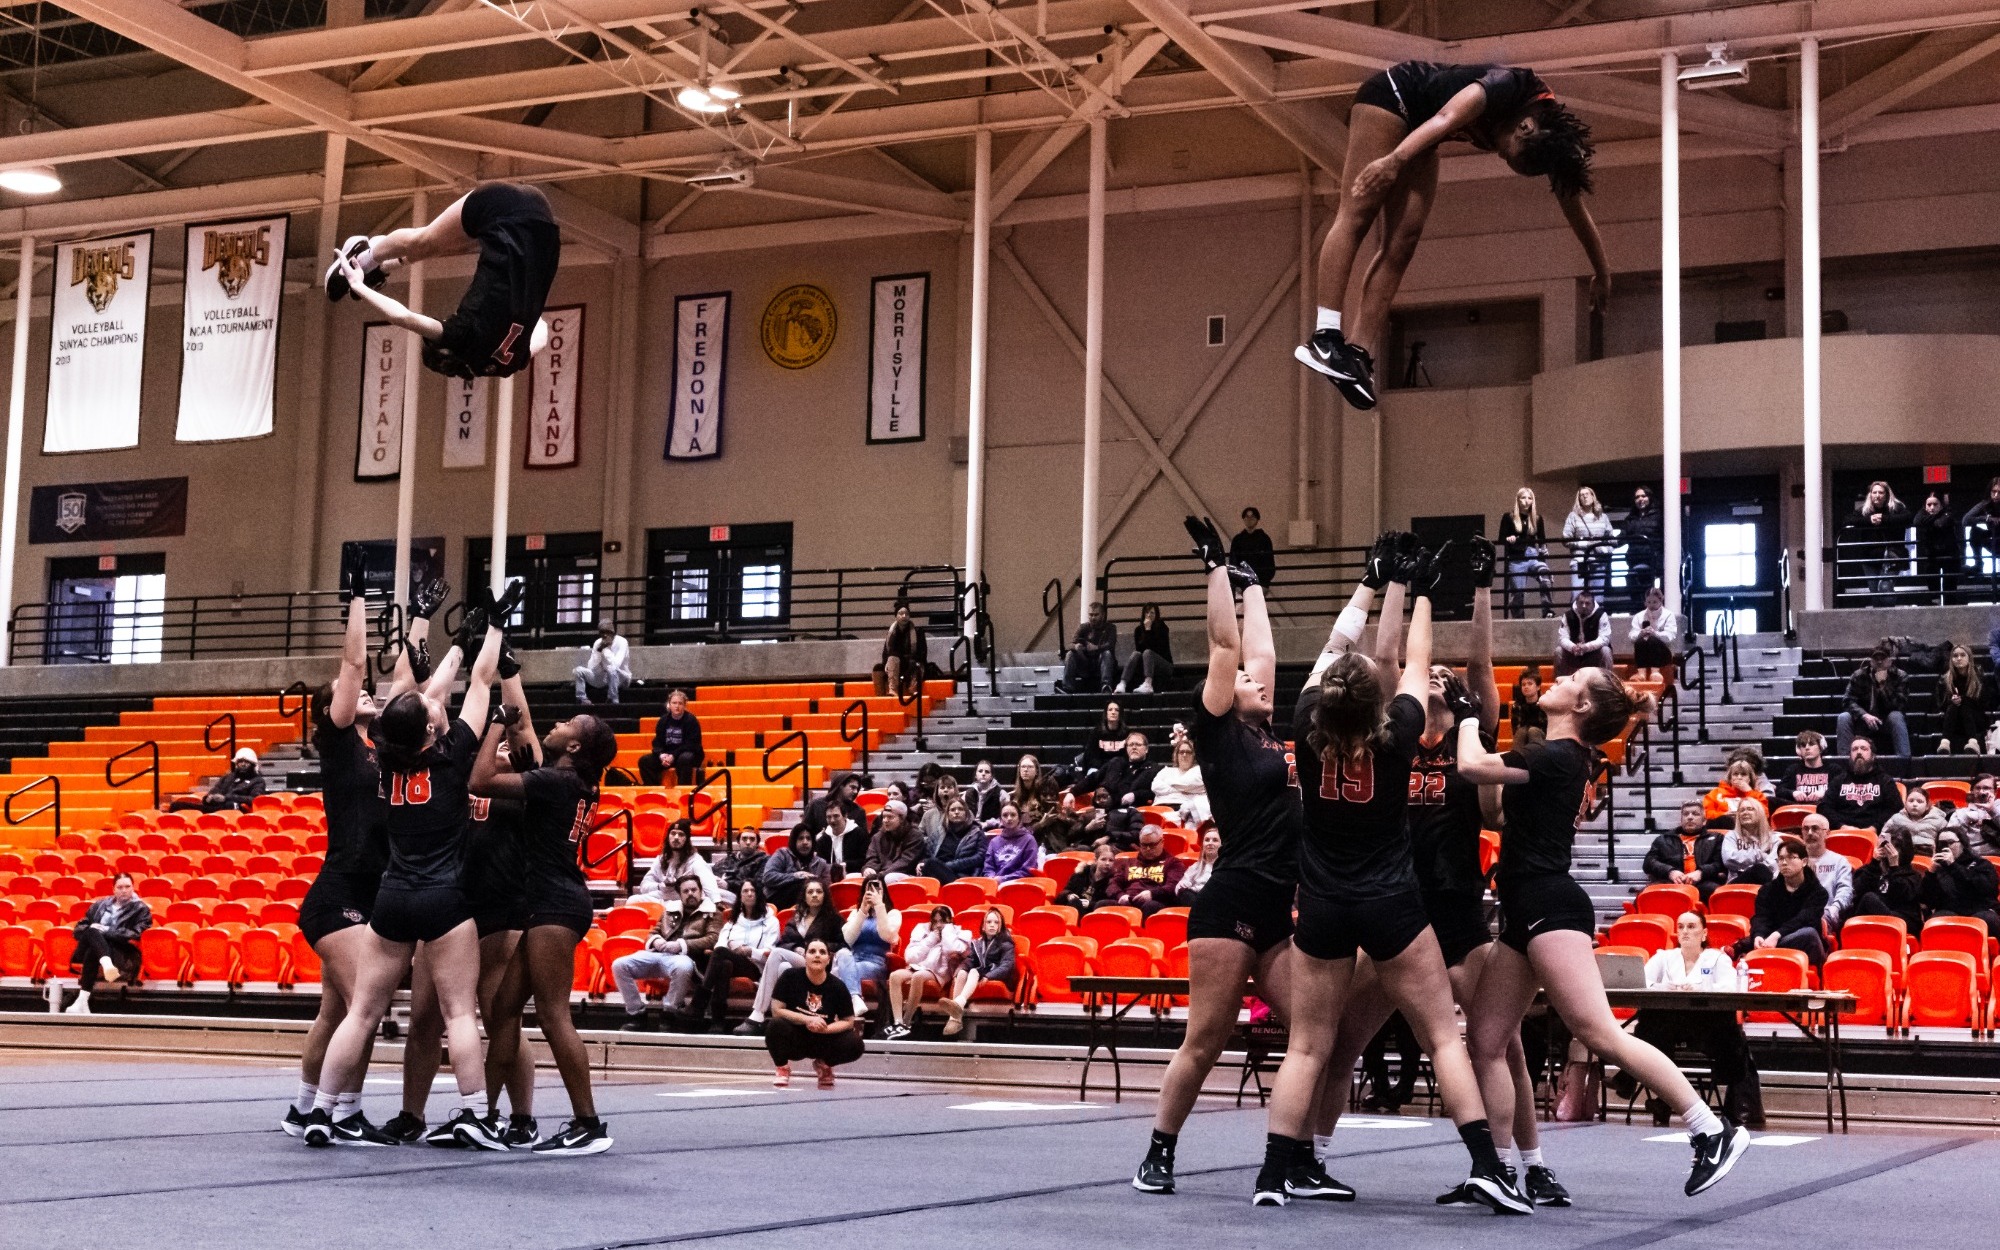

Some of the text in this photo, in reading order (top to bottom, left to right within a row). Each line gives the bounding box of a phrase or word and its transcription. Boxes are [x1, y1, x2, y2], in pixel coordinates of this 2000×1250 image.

[72, 320, 124, 334] VOLLEYBALL
[189, 319, 274, 336] NCAA TOURNAMENT
[204, 306, 260, 320] VOLLEYBALL
[59, 333, 138, 351] SUNYAC CHAMPIONS
[889, 285, 906, 432] MORRISVILLE
[545, 318, 563, 457] CORTLAND
[688, 303, 707, 453] FREDONIA
[373, 339, 393, 462] BUFFALO
[459, 379, 473, 439] NTON
[63, 502, 80, 518] 50
[390, 767, 432, 805] 18
[1320, 747, 1375, 803] 19
[1407, 771, 1445, 805] 22
[1818, 864, 1836, 873] STATE
[1251, 1027, 1289, 1035] BENGAL
